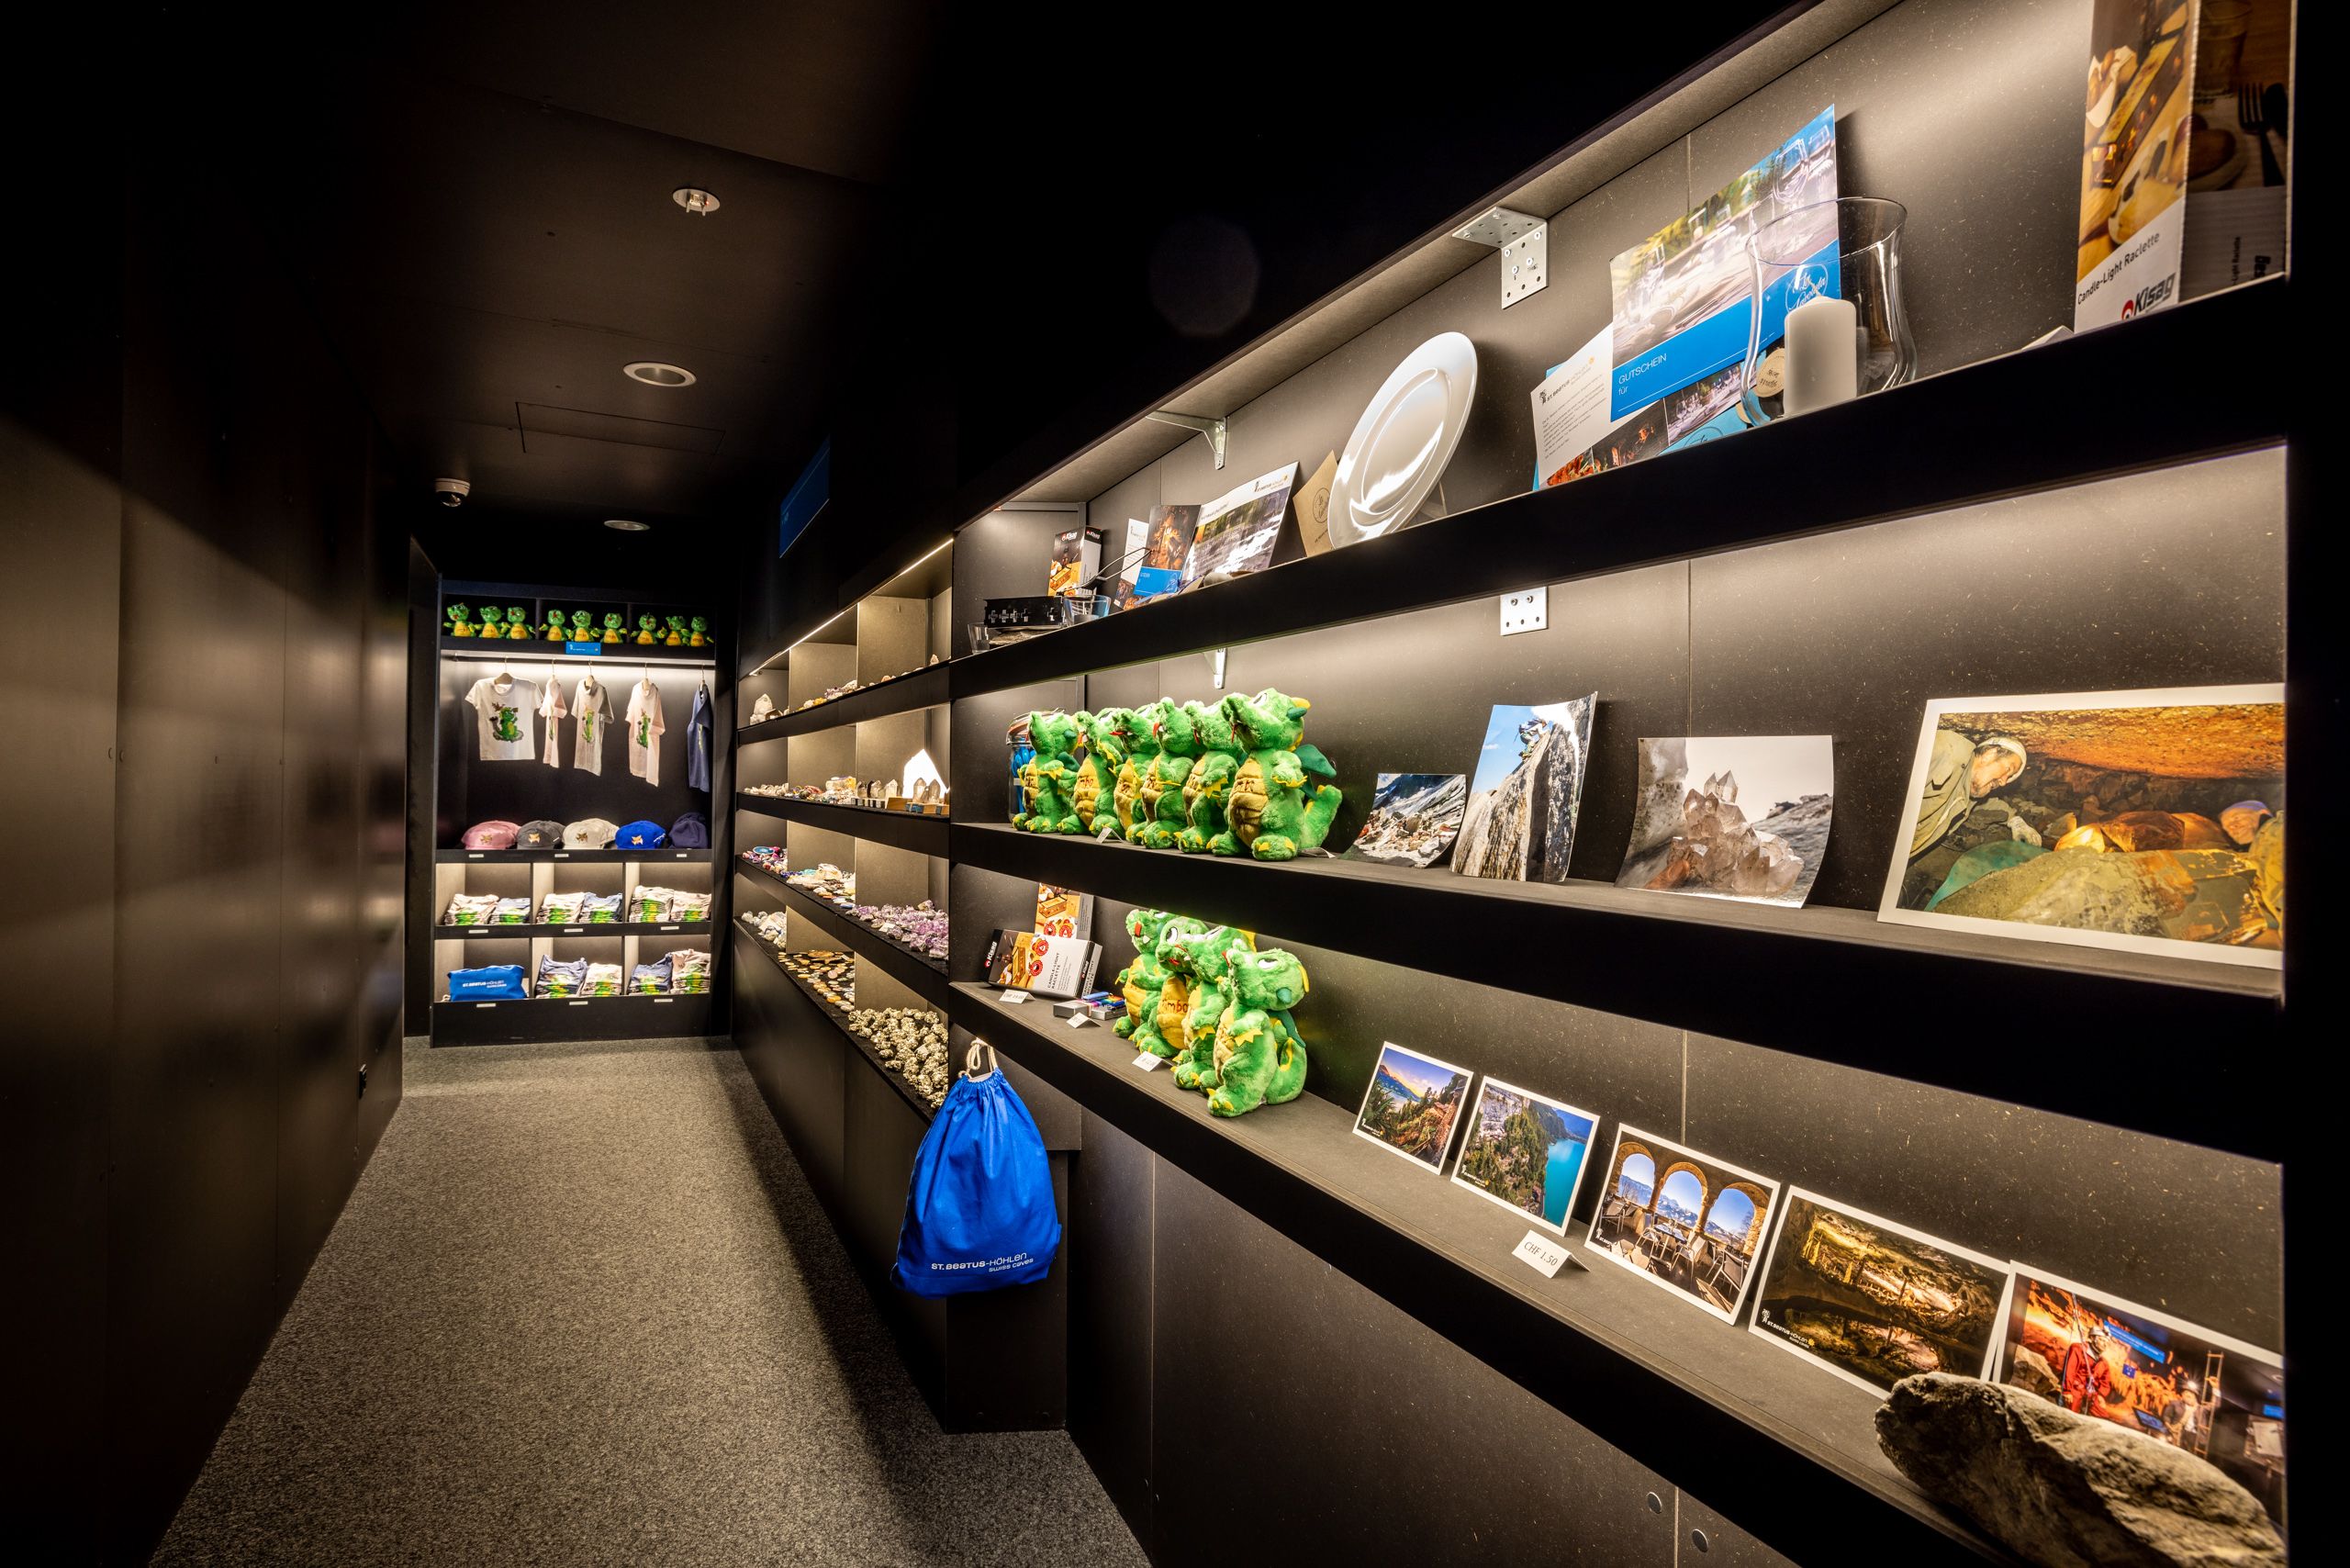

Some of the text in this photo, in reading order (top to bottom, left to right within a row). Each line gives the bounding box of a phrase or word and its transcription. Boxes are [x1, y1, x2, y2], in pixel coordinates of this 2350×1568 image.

[2077, 232, 2160, 305] Candle-Light Raclette
[2134, 272, 2177, 316] Kisag
[1618, 353, 1667, 385] GUTSCHEIN
[1618, 385, 1628, 396] für
[988, 941, 998, 961] Kisag
[1047, 953, 1059, 989] CANDLE-LIGHT
[1051, 965, 1060, 990] RACLETTE
[1524, 1241, 1559, 1266] CHF 1.50
